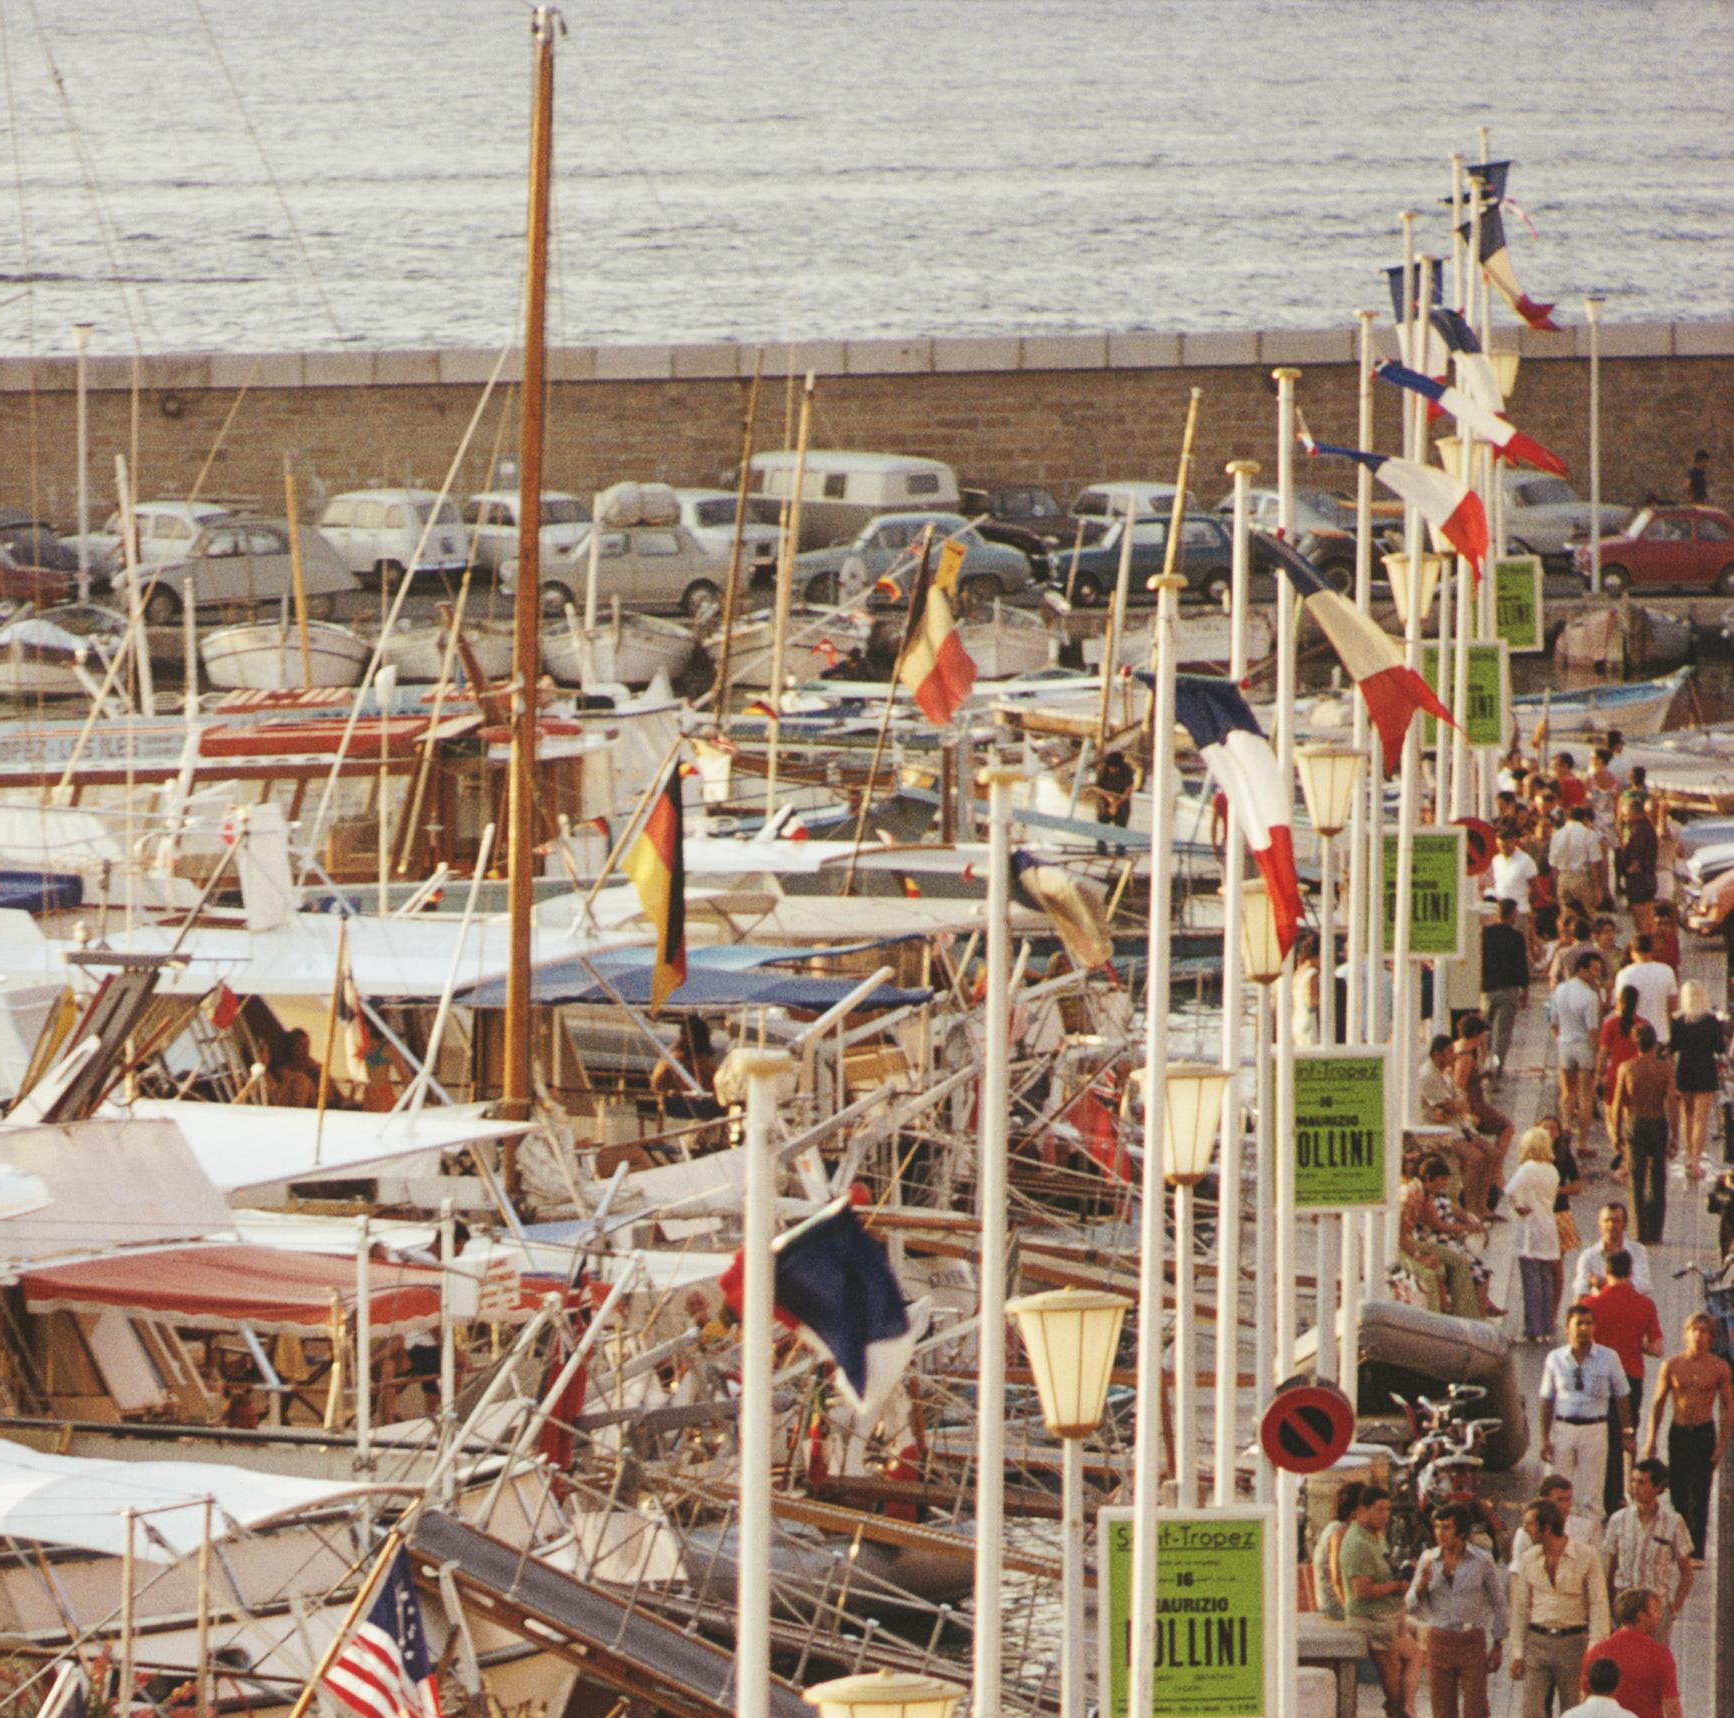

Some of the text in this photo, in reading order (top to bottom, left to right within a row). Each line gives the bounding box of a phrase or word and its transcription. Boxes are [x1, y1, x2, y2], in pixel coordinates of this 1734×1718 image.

[1296, 1130, 1375, 1169] OLLINI
[1176, 1571, 1195, 1588] 16
[1155, 1596, 1230, 1613] AURIZIO
